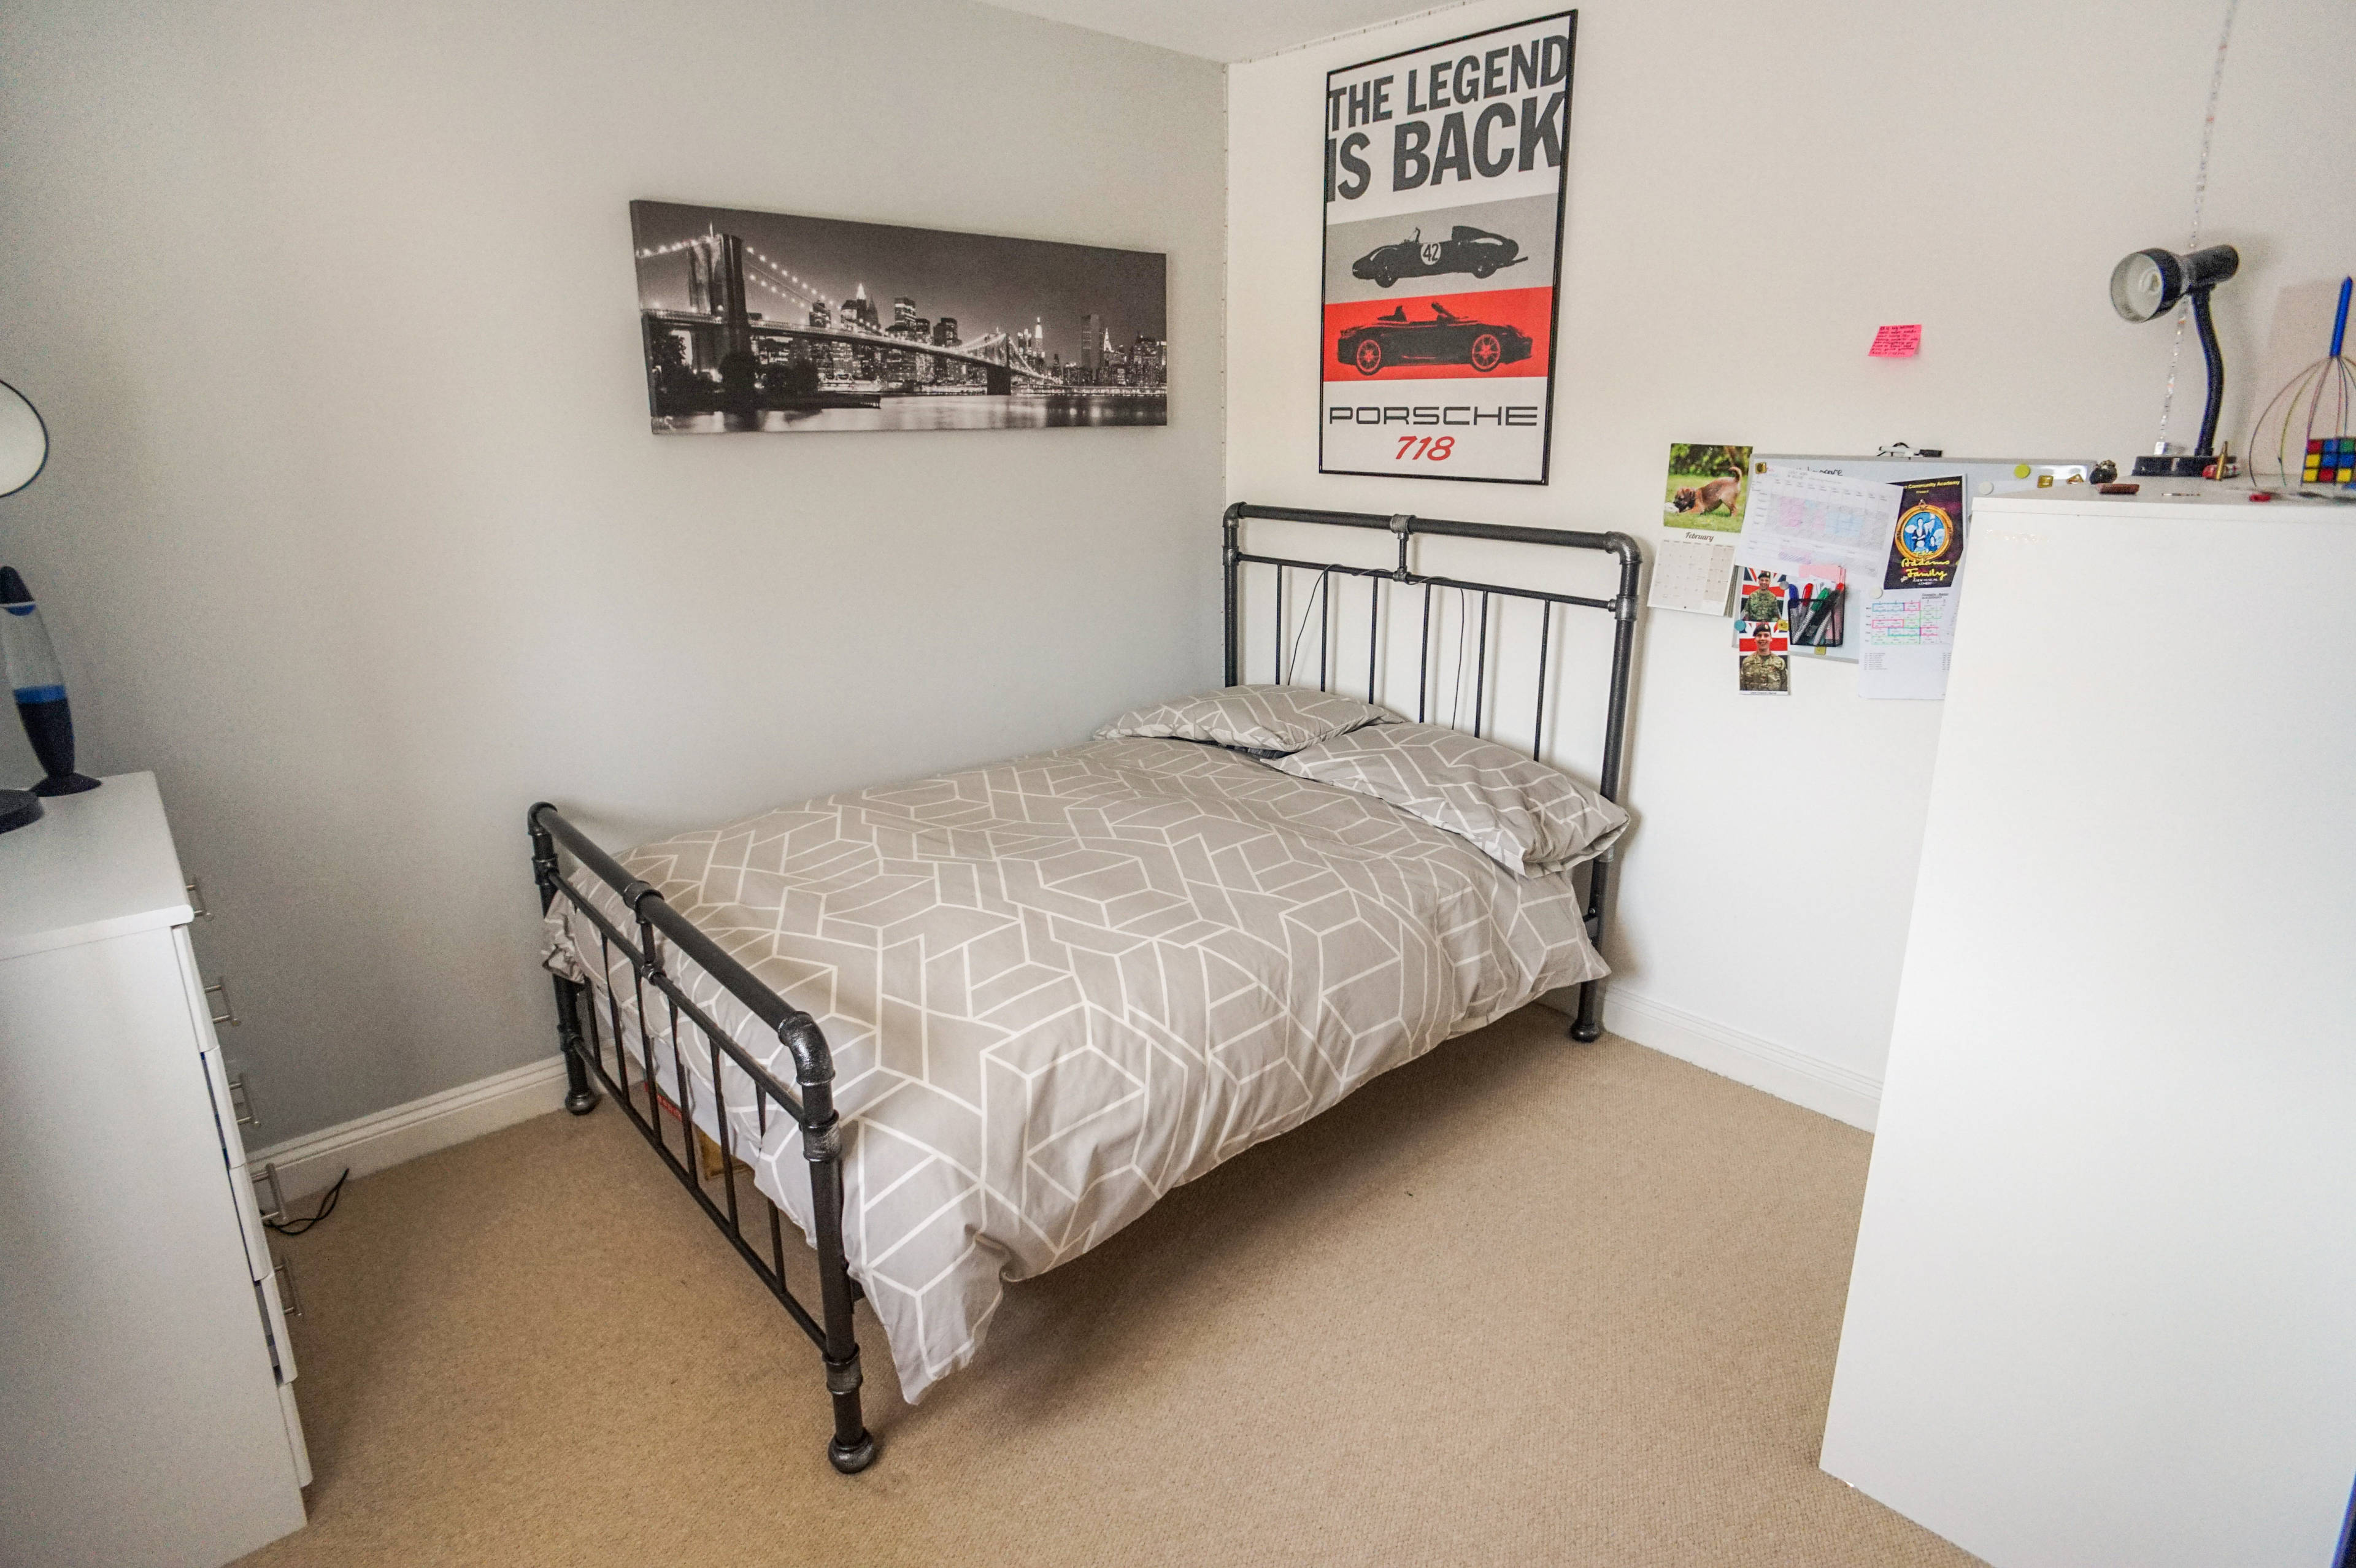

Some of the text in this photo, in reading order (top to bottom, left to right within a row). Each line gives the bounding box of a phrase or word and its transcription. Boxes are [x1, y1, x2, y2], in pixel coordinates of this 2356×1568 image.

[1330, 34, 1569, 132] THE LEGEND
[1326, 91, 1565, 202] IS BACK
[1423, 243, 1439, 261] 42
[1330, 406, 1538, 426] PORSCHE
[1395, 436, 1455, 461] 718
[1685, 532, 1714, 542] February
[1901, 558, 1950, 567] Addams
[1906, 569, 1947, 581] Family
